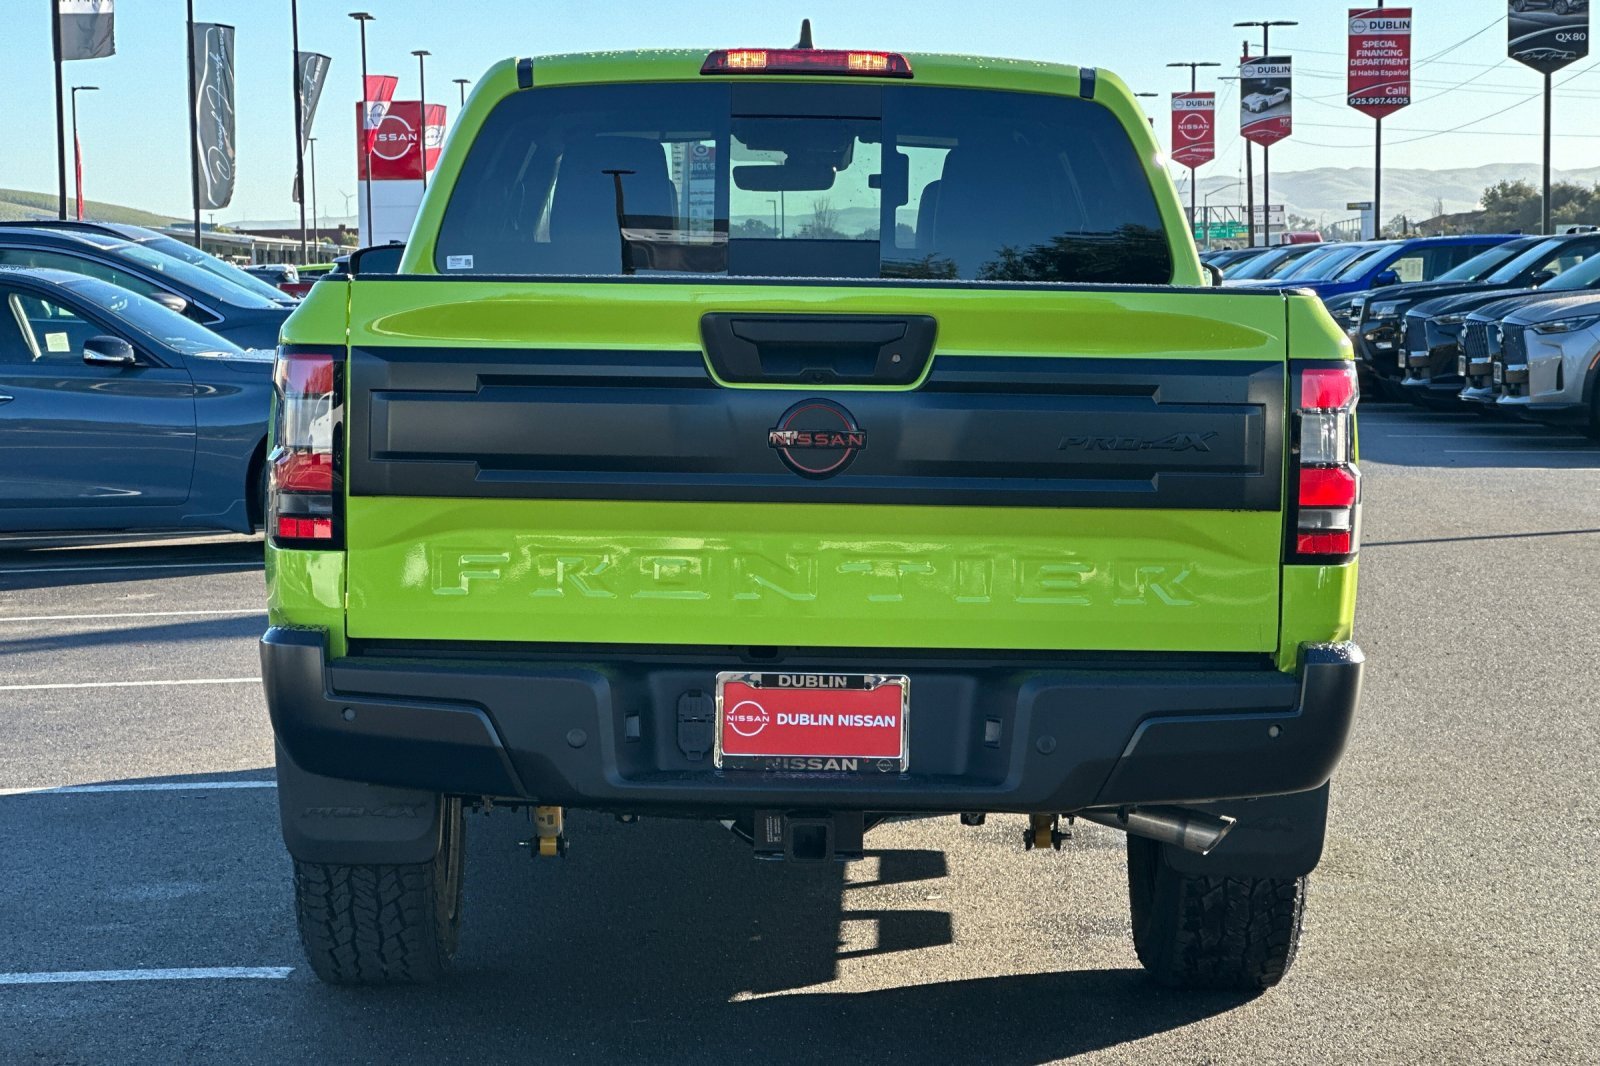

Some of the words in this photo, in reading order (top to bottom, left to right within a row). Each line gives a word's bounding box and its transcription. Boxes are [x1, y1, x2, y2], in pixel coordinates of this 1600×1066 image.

[1369, 21, 1410, 29] DUBLIN
[1555, 33, 1587, 42] QX80
[1362, 40, 1398, 48] SPECIAL
[1356, 49, 1403, 57] FINANCING
[1350, 58, 1409, 66] DEPARTMENT
[1257, 66, 1291, 74] DUBLIN
[1380, 69, 1409, 77] Español
[1385, 86, 1407, 95] Call!
[1350, 97, 1409, 105] 925.997.4505
[771, 434, 863, 446] NISSAN
[1057, 431, 1220, 451] PRO-4X
[430, 548, 1200, 606] FRONTIER
[778, 674, 848, 688] DUBLIN
[727, 714, 770, 723] NISSAN
[776, 713, 834, 726] DUBLIN
[838, 714, 896, 728] NISSAN
[765, 757, 858, 771] NISSAN
